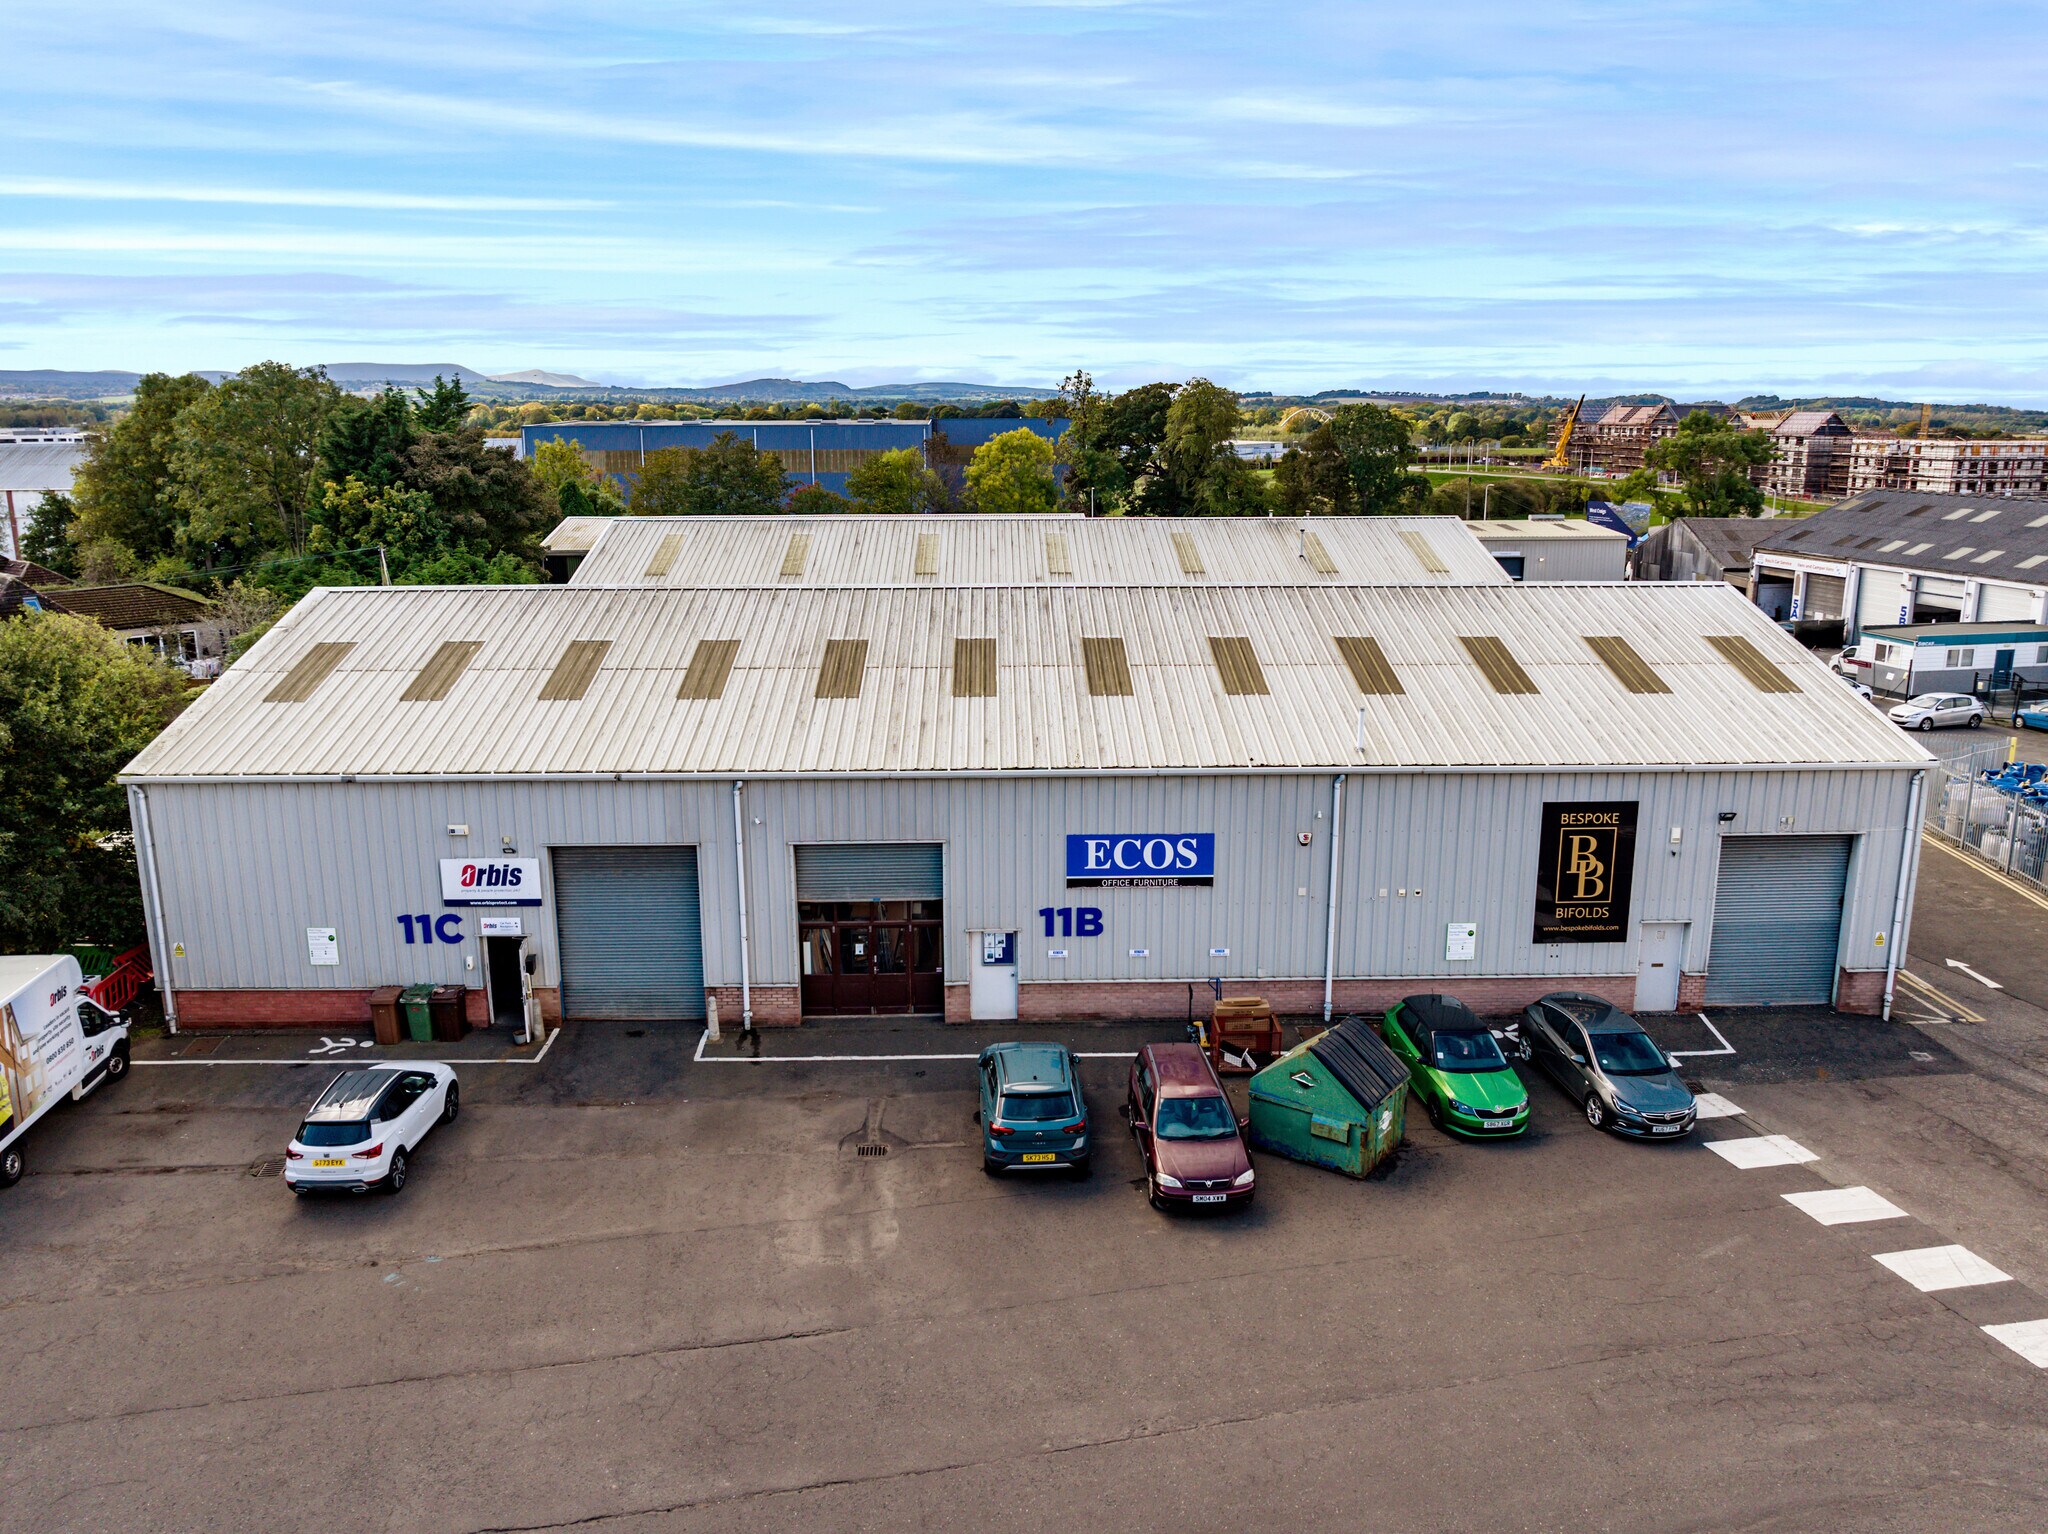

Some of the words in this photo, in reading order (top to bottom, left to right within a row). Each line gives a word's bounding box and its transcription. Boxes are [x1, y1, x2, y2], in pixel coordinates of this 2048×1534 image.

[1560, 812, 1620, 824] BESPOKE
[1084, 838, 1198, 870] ECOS
[460, 864, 522, 887] Orbis
[1102, 879, 1130, 887] OFFICE
[1039, 907, 1104, 937] 11B
[1555, 907, 1609, 918] BIFOLDS
[397, 914, 465, 944] 11C
[49, 986, 67, 1007] Orbis
[91, 1044, 104, 1061] Orbis
